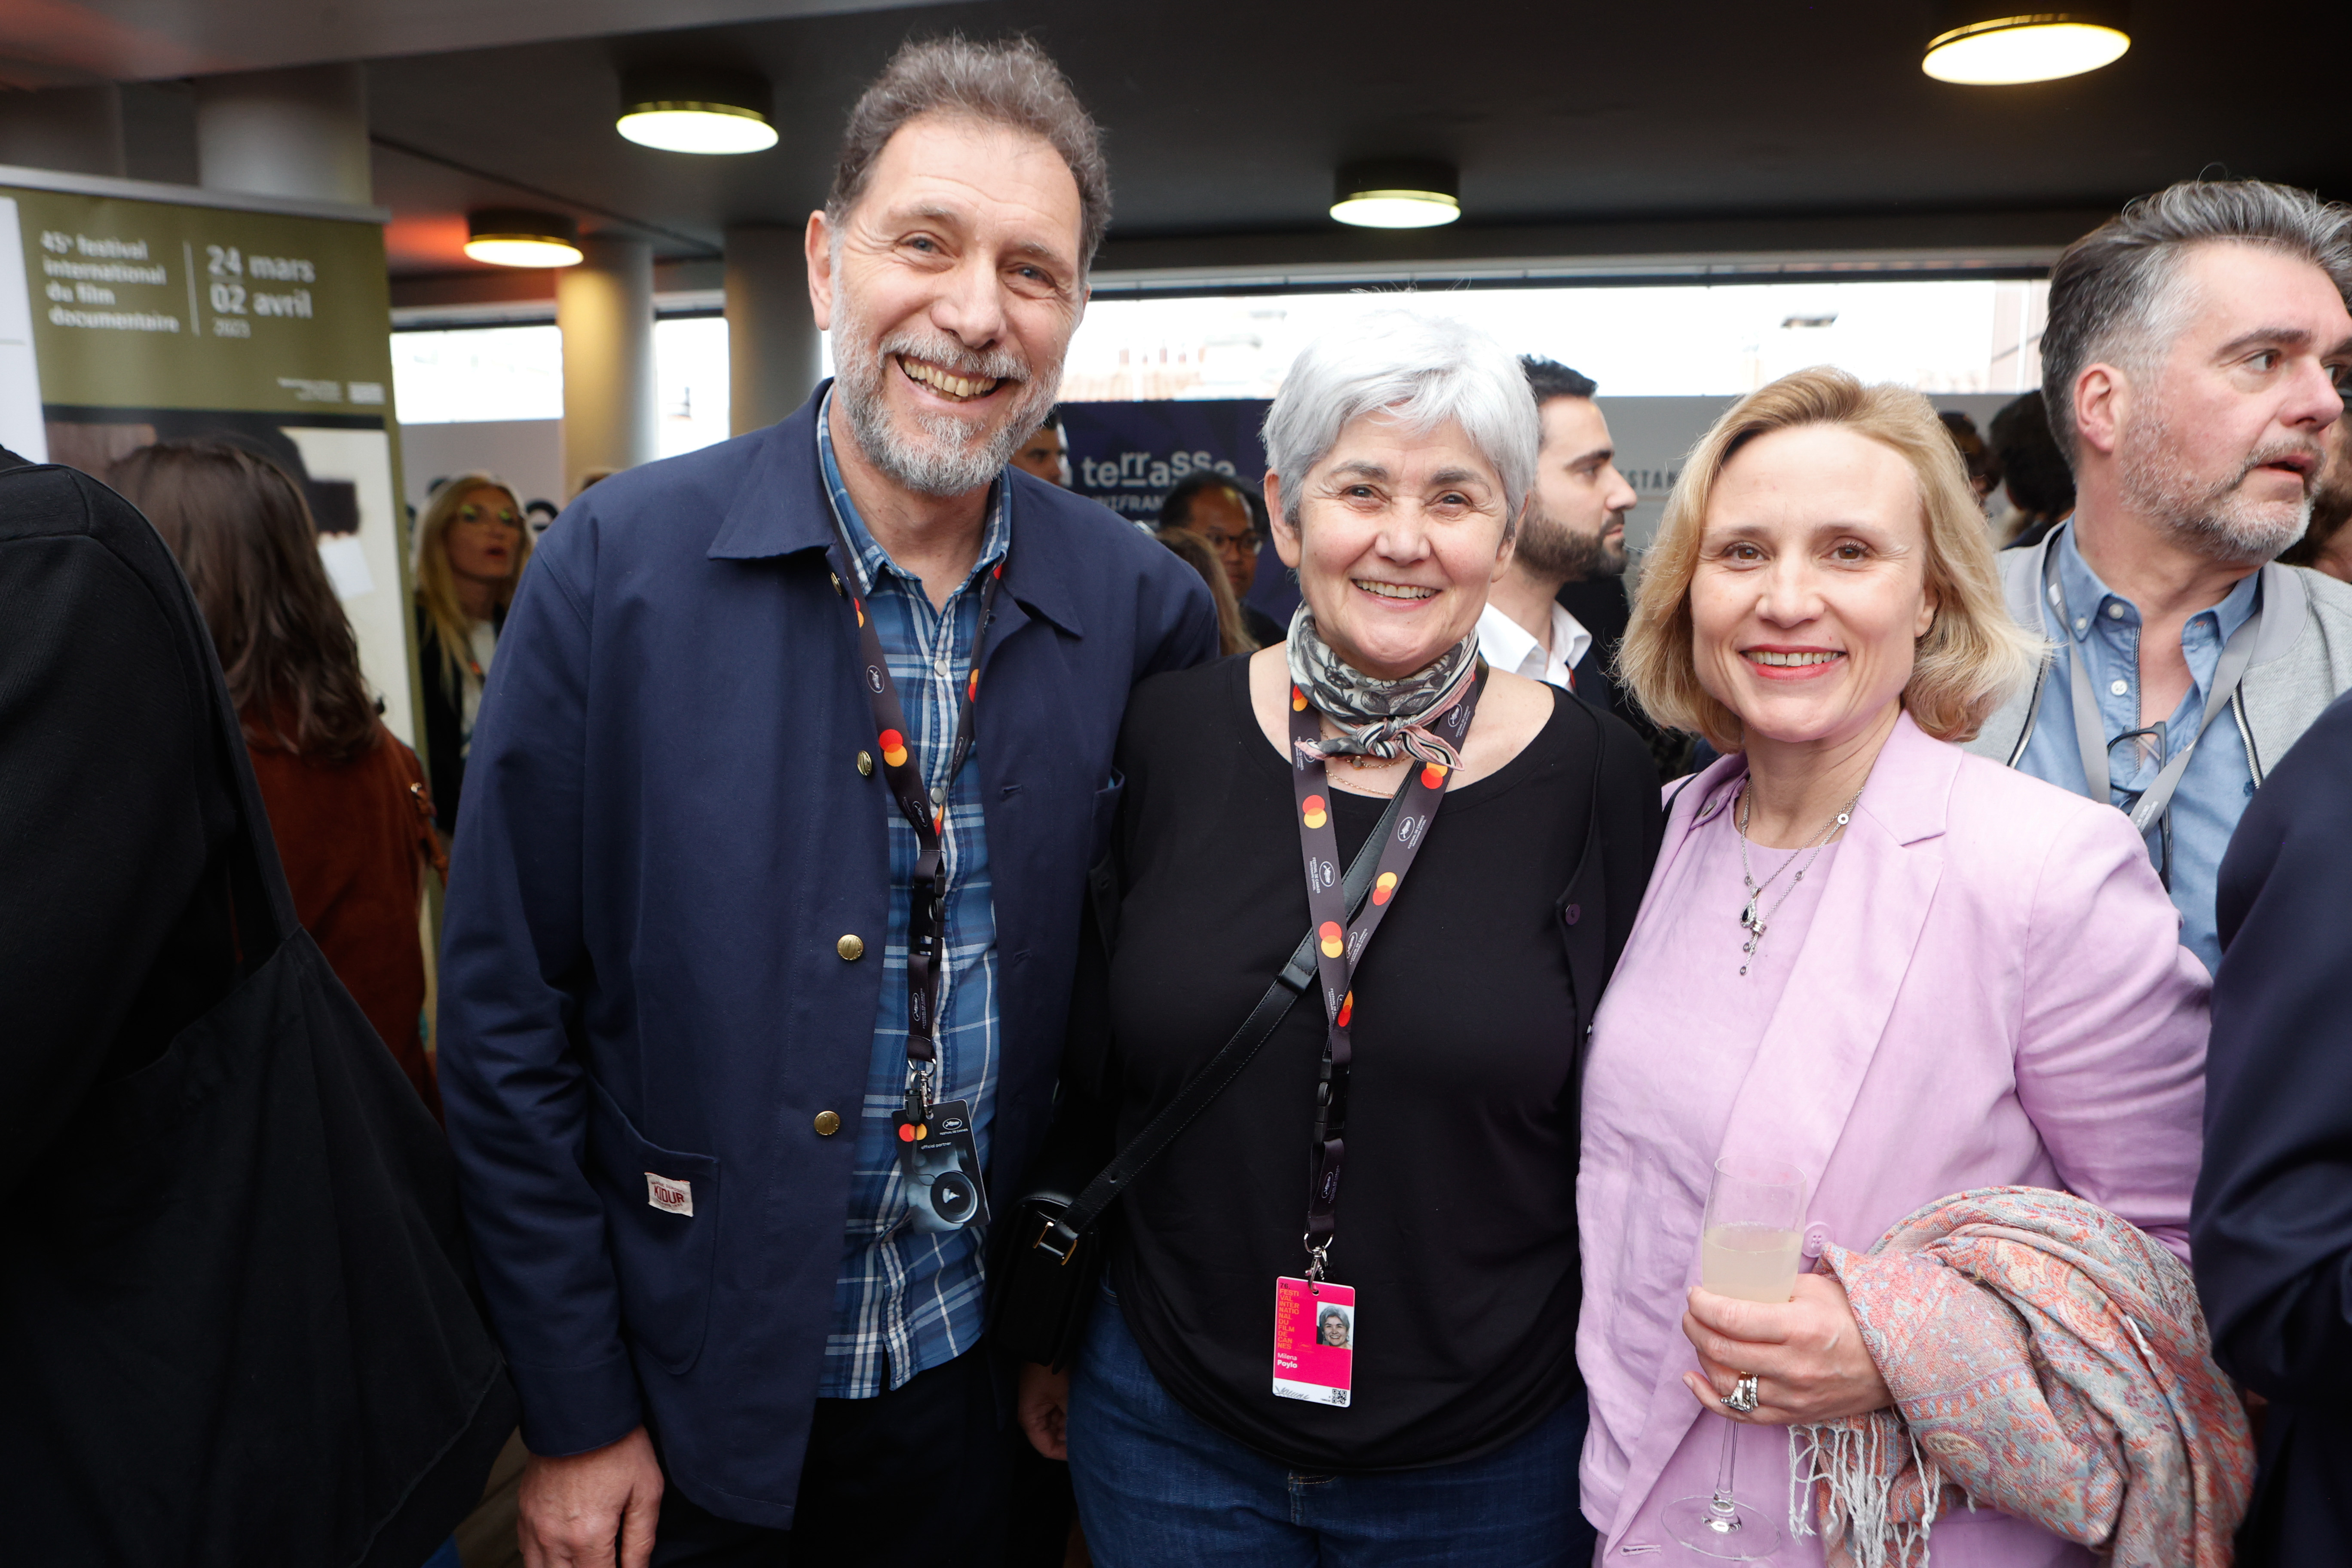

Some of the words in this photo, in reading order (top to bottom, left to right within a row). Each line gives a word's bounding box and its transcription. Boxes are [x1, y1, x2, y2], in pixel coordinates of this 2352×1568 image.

[77, 233, 148, 260] festival
[43, 254, 167, 285] international
[206, 244, 242, 276] 24
[248, 255, 316, 283] mars
[46, 279, 74, 302] du
[75, 281, 115, 305] film
[210, 282, 248, 315] 02
[253, 288, 312, 318] avril
[48, 304, 181, 333] documentaire
[1407, 834, 1417, 848] FESTIVAL
[1416, 815, 1425, 829] CANNES
[1358, 928, 1367, 942] CANNES
[654, 1185, 685, 1204] KIDUR
[1279, 1301, 1299, 1309] INTER
[1277, 1352, 1297, 1361] Milena
[1277, 1359, 1298, 1369] Poylo
